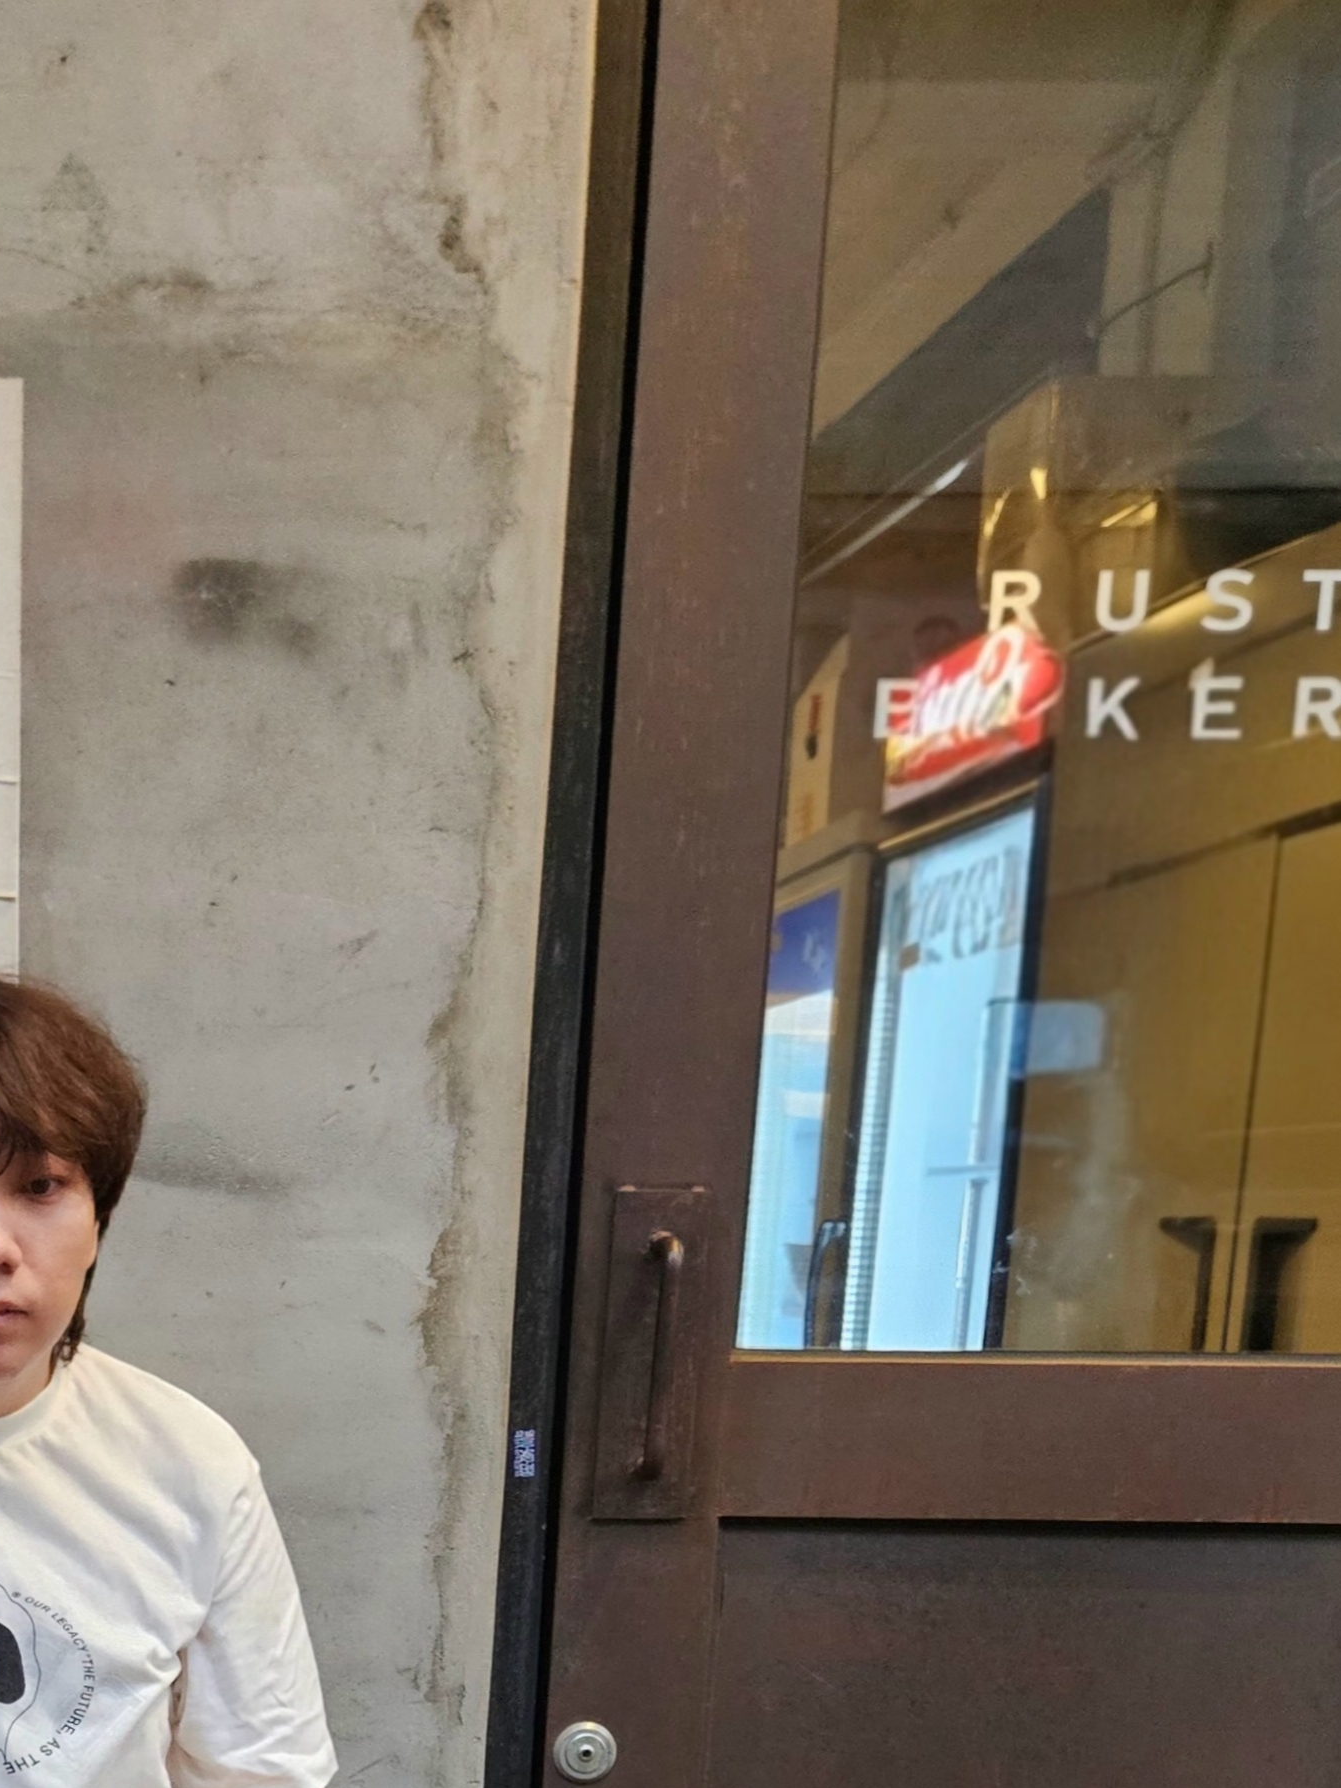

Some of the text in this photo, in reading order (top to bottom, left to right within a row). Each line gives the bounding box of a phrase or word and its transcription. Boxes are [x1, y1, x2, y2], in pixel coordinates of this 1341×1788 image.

[989, 569, 1341, 633] RUST
[39, 1737, 61, 1757] AS
[2, 1754, 41, 1775] THE
